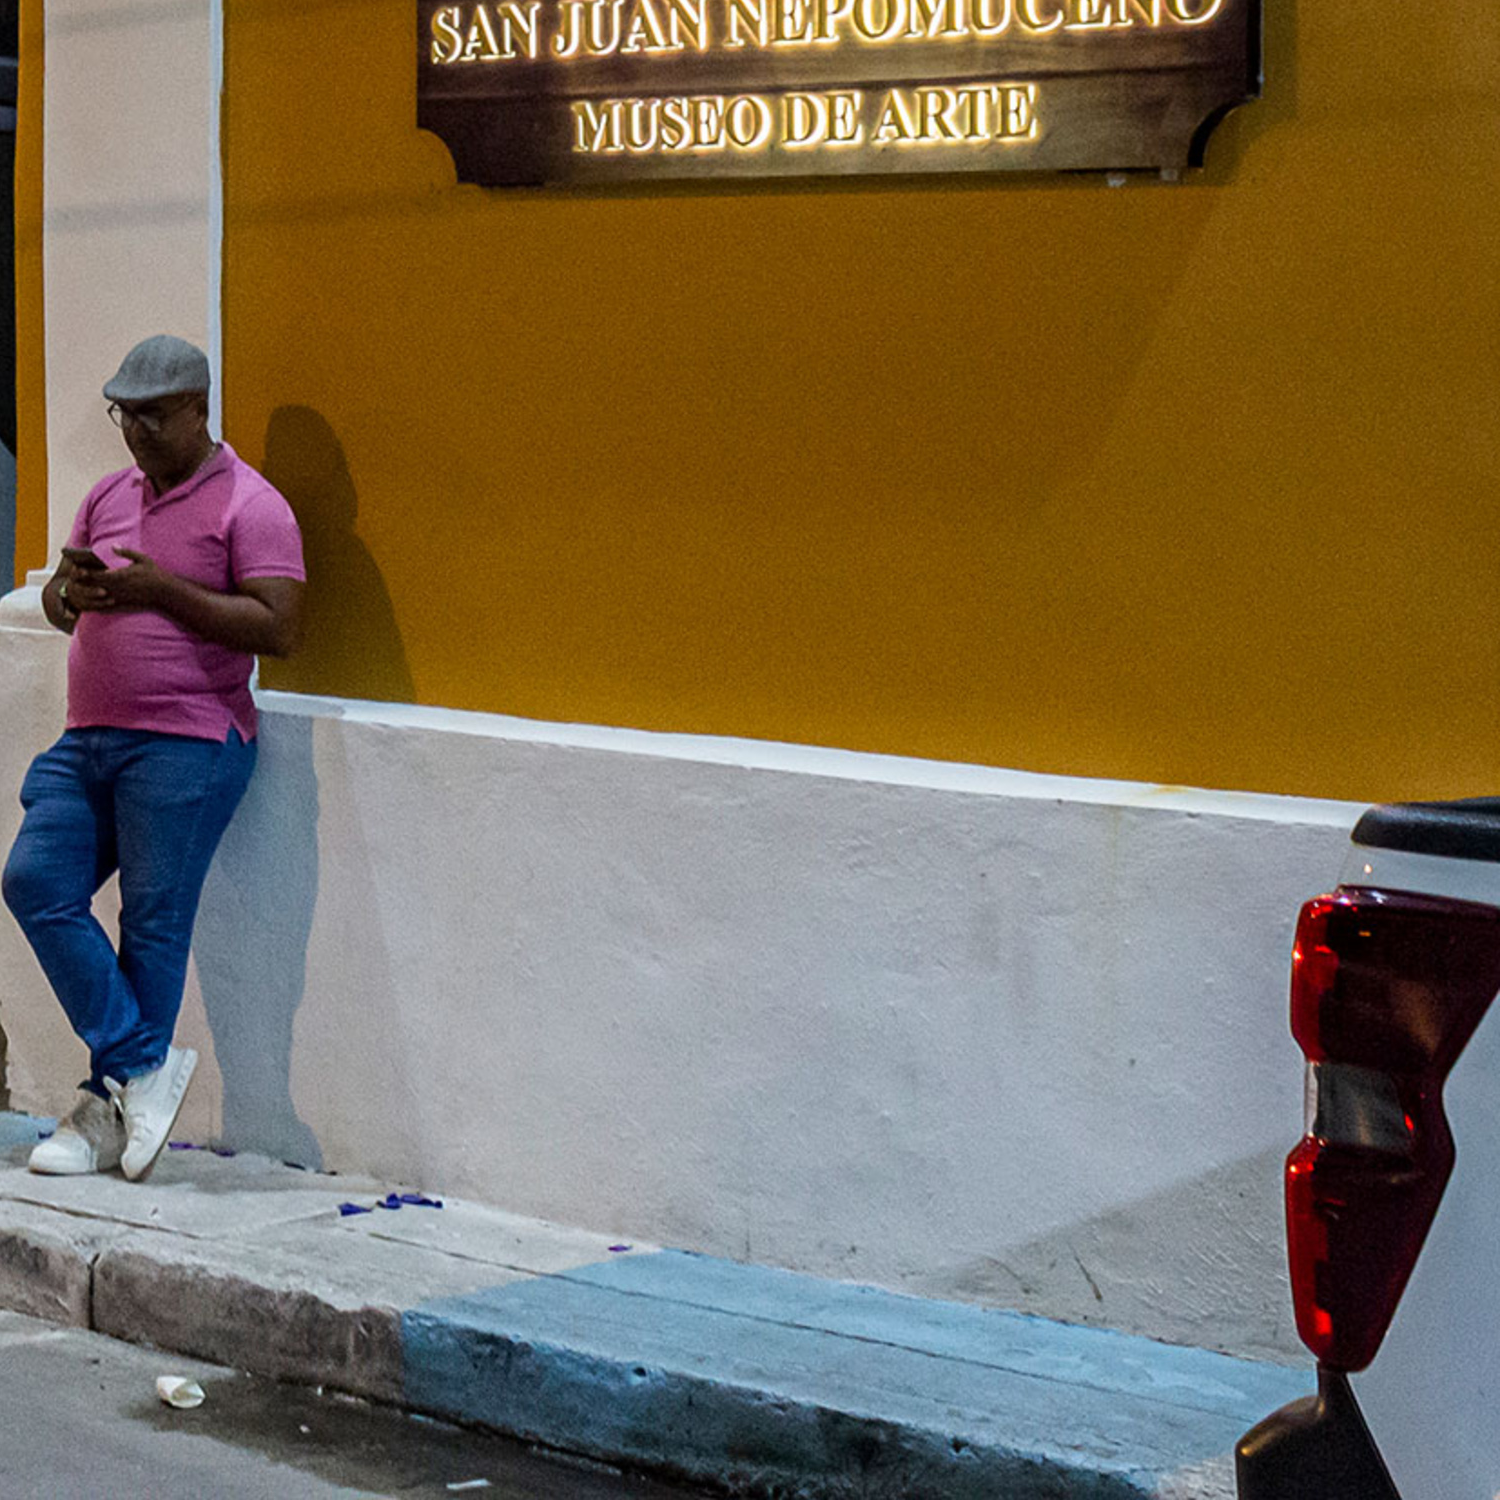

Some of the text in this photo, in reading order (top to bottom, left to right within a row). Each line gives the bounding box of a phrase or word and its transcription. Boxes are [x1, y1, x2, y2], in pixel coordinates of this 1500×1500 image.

[431, 2, 541, 65] SAN
[571, 84, 1037, 153] MUSEO DE ARTE
